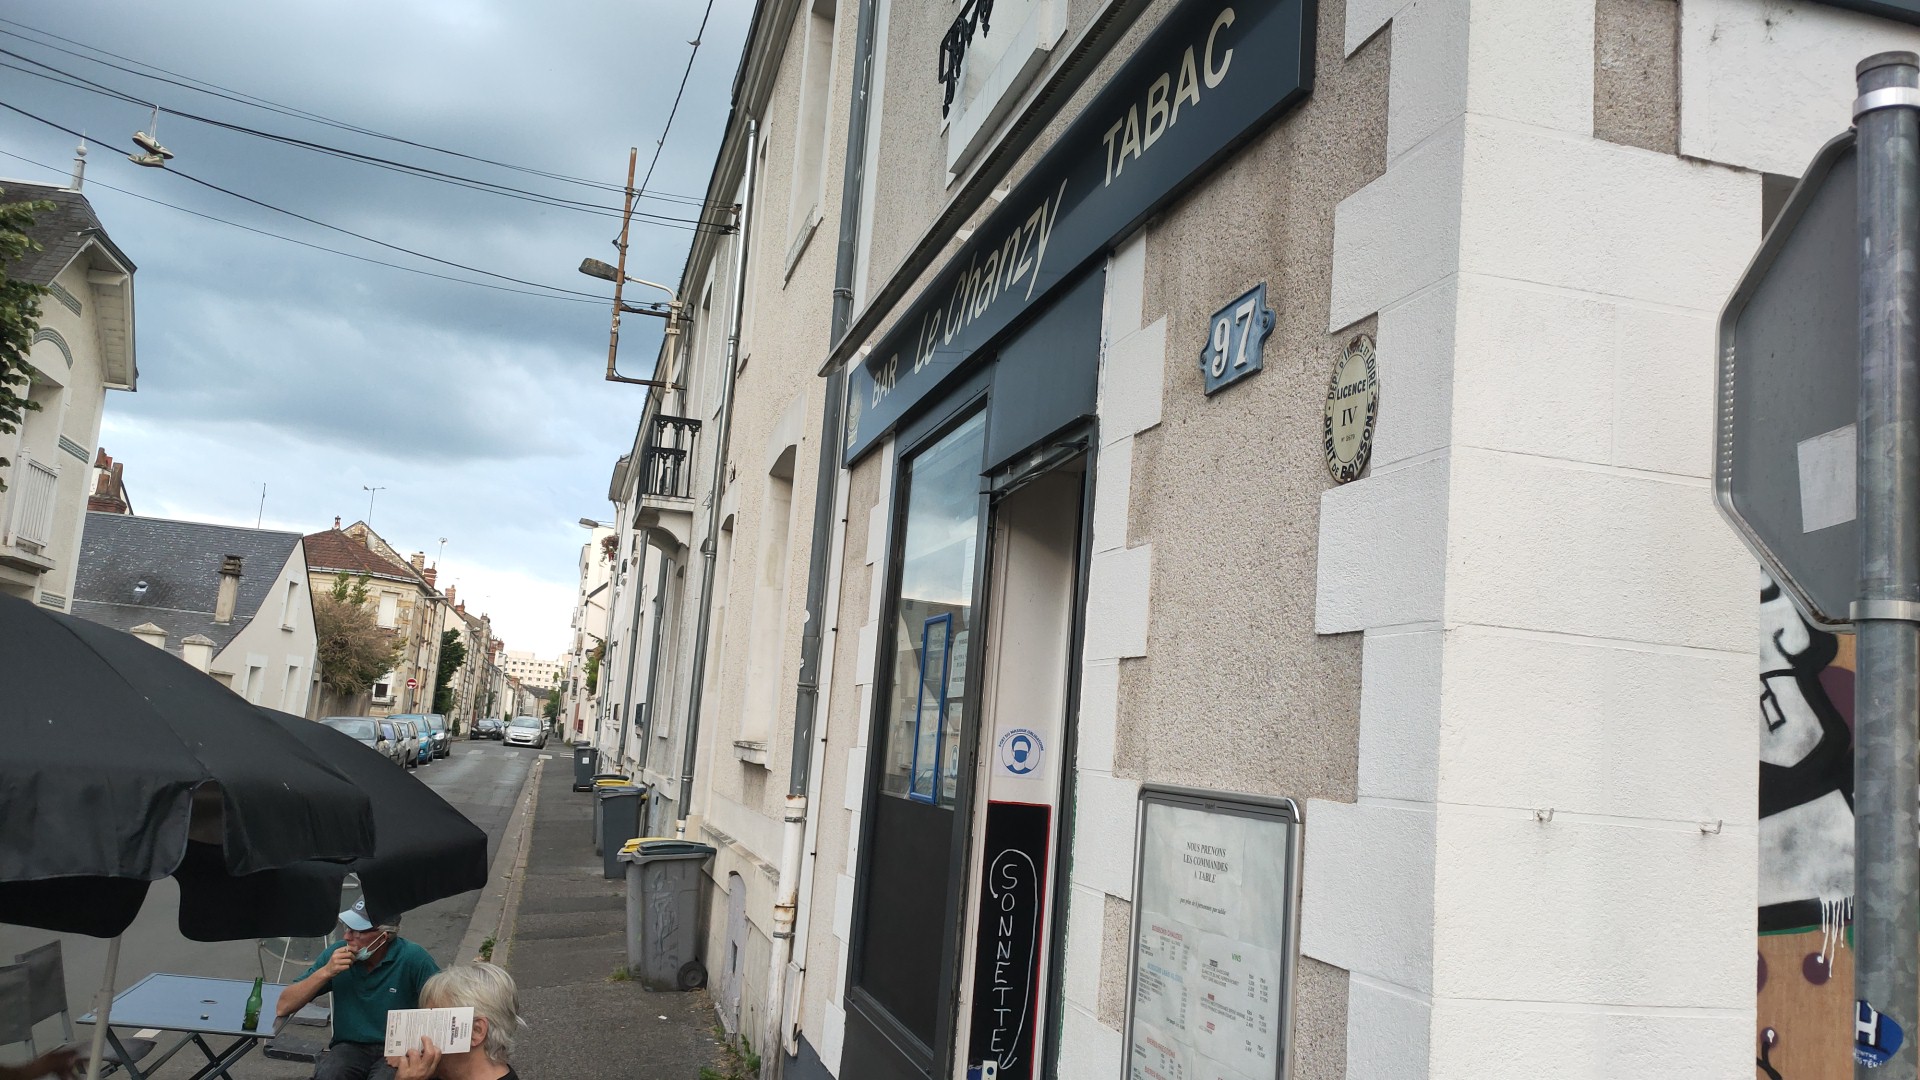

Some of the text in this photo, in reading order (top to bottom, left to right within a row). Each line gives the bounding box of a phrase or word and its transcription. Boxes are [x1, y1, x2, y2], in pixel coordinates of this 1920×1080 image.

[871, 7, 1236, 410] BAR Le Chanzy TABAC
[1211, 299, 1257, 379] 97
[1365, 352, 1377, 389] LOIRE
[1336, 378, 1367, 401] LICENCE
[1341, 405, 1358, 428] IV
[1324, 402, 1376, 480] DEBIT DE BOISSONS
[1183, 853, 1229, 873] LES COMMANDES
[1186, 841, 1227, 858] NOUS PRENONS
[1198, 870, 1217, 884] TABLE
[991, 863, 1019, 1052] SONNETTE
